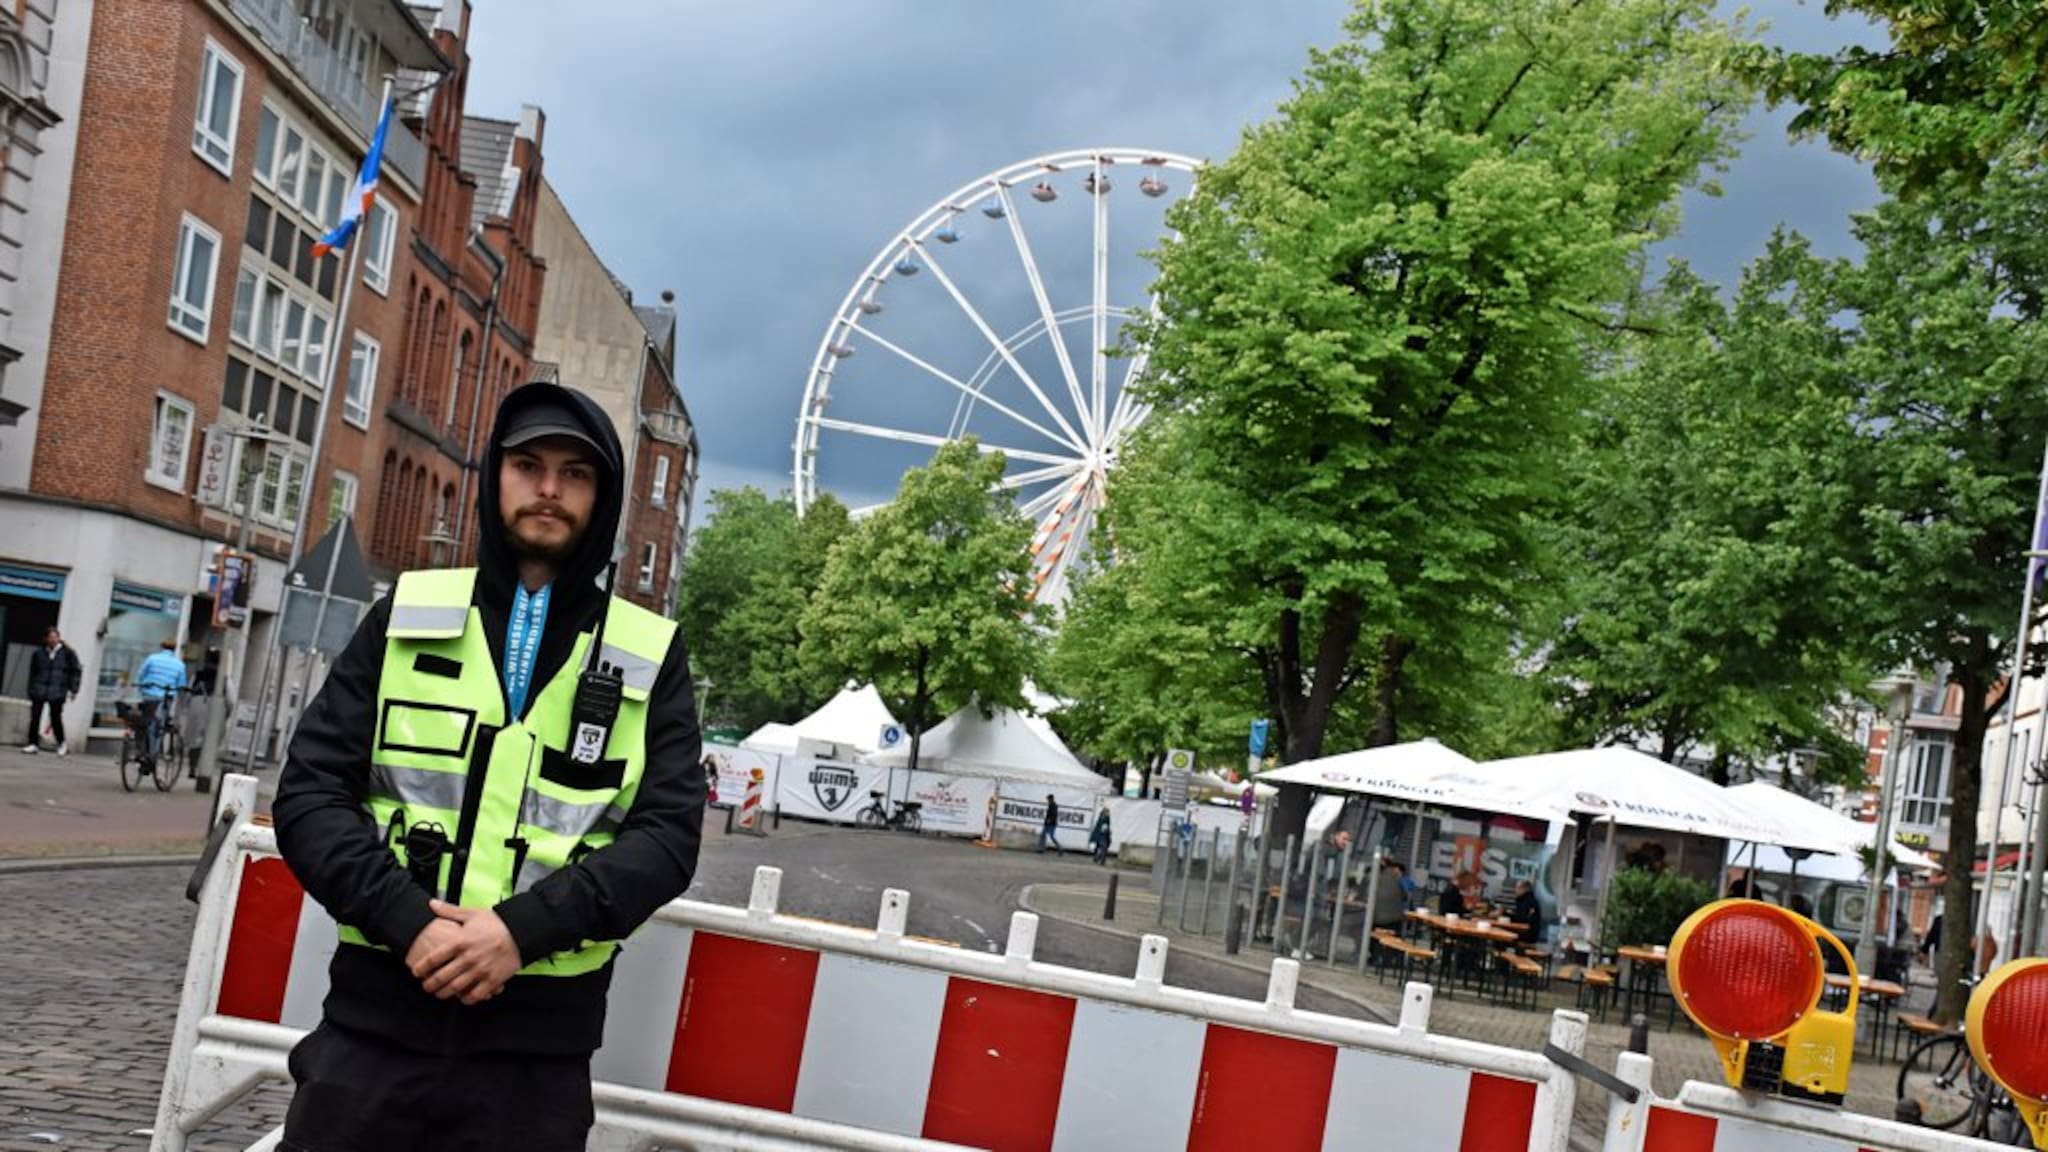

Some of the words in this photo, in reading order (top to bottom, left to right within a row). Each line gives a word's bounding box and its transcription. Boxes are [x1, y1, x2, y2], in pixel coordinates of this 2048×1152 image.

[1003, 803, 1045, 819] BEWACH
[1058, 811, 1085, 825] URCH
[1429, 840, 1508, 881] EIS
